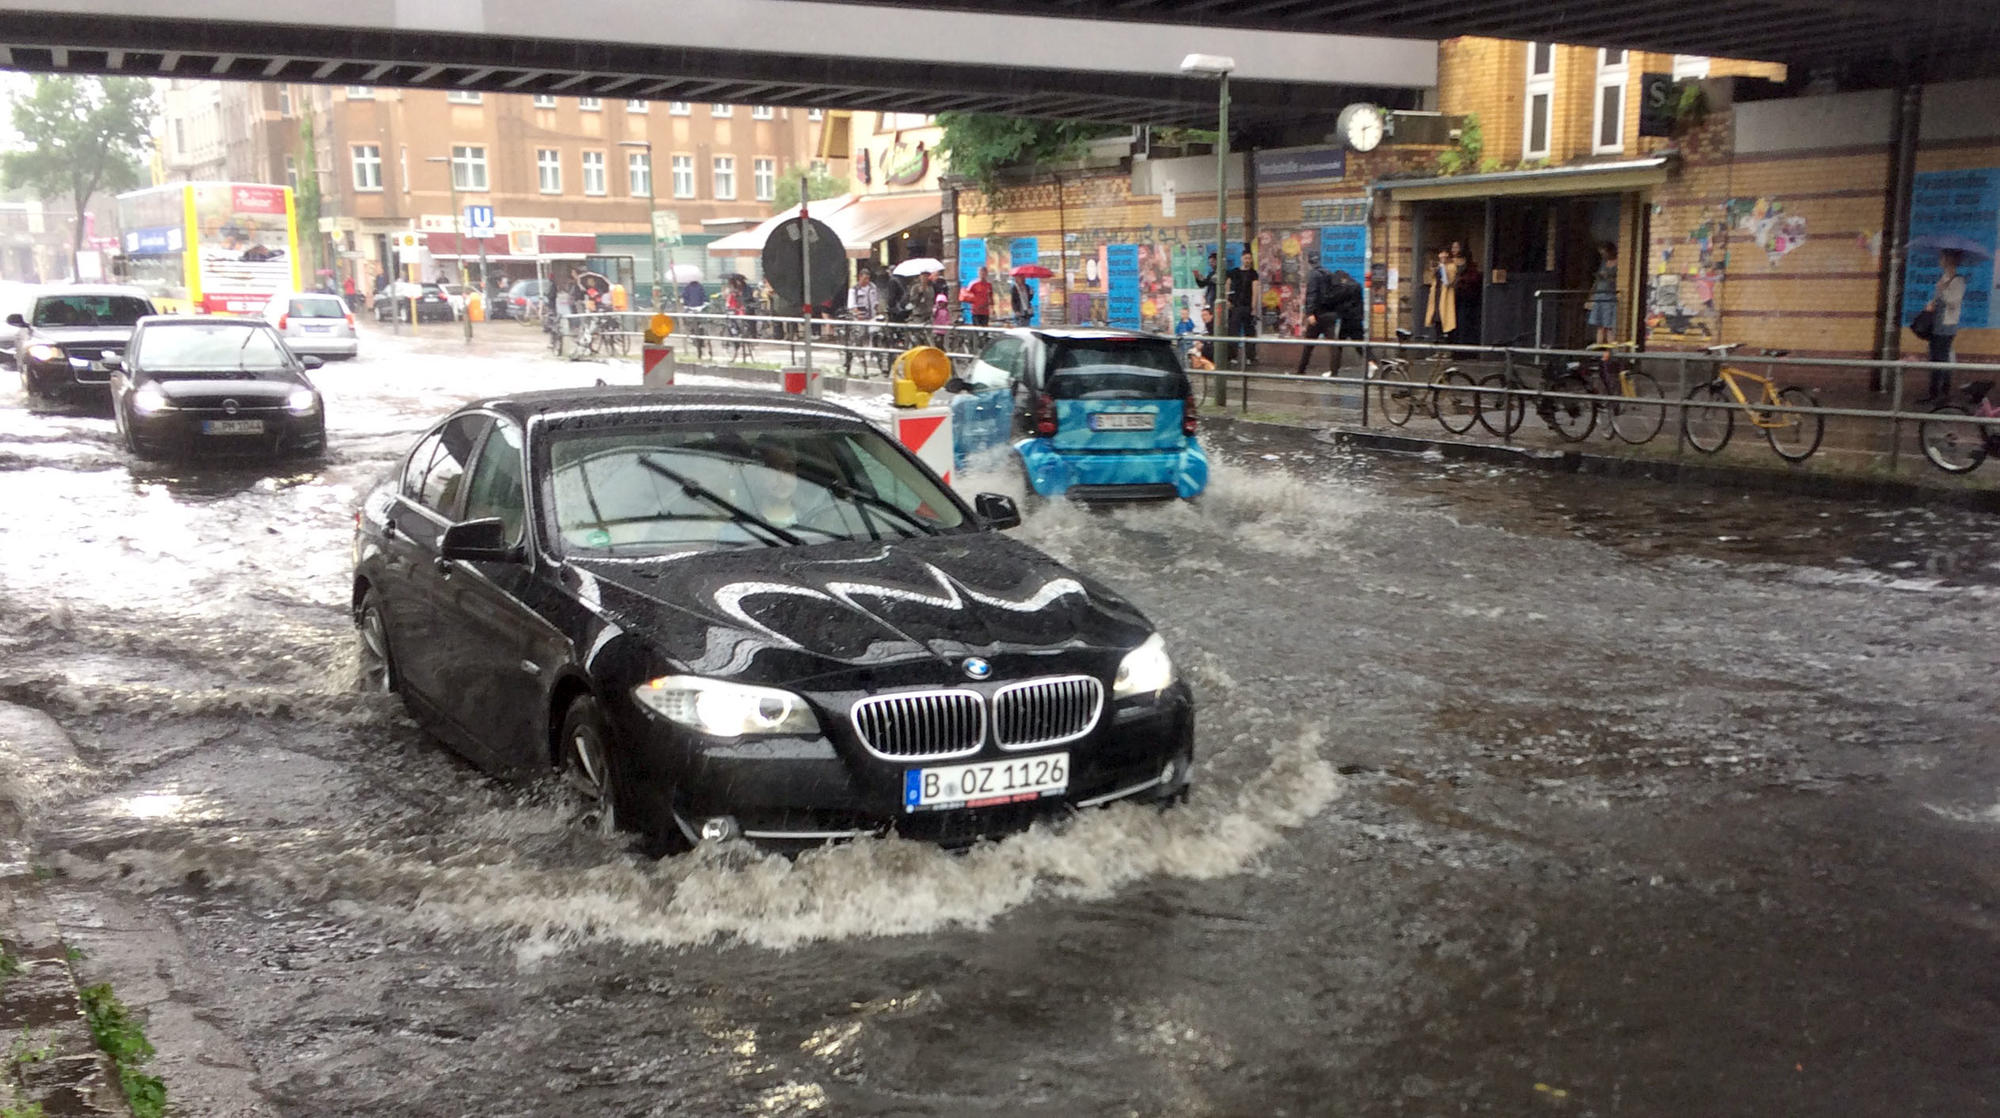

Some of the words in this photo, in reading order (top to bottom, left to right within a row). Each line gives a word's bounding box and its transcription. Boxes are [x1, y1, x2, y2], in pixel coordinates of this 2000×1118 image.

[1650, 82, 1665, 107] S
[474, 207, 492, 227] U
[924, 773, 940, 798] B
[961, 767, 994, 795] OZ
[1003, 758, 1064, 790] 1126
